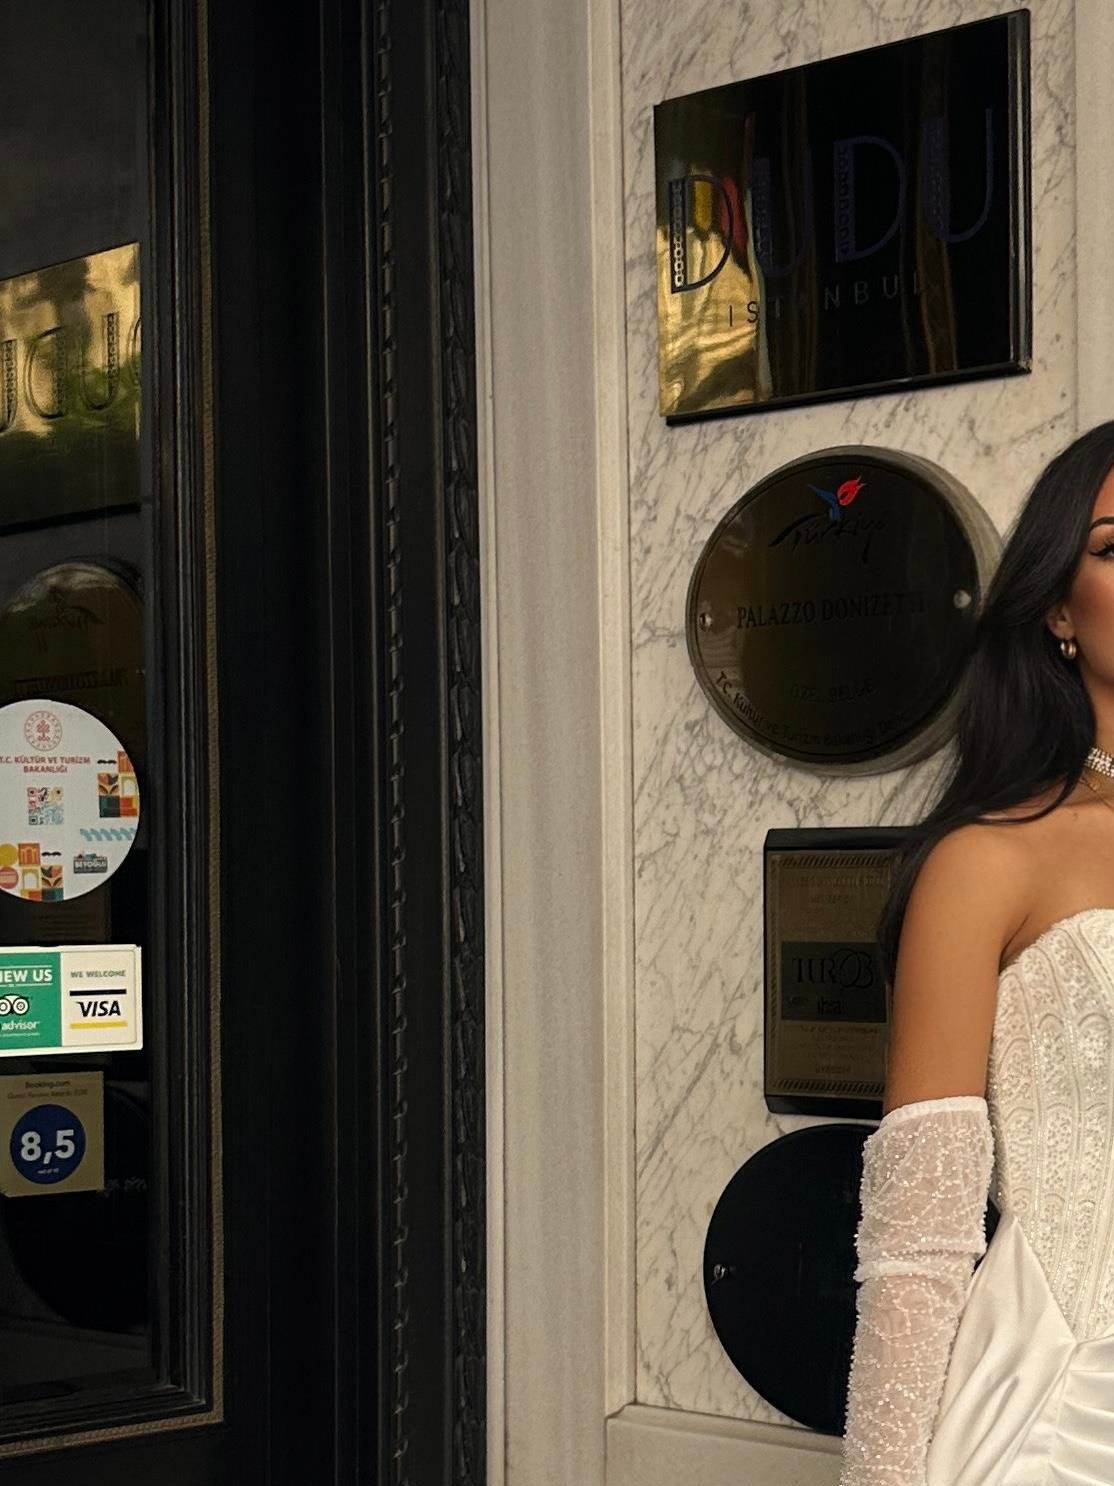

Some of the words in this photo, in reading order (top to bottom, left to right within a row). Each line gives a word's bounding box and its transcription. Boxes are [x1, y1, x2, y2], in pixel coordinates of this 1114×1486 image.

[737, 601, 816, 629] PALAZZO
[33, 969, 53, 982] US
[86, 970, 126, 978] WELCOME
[76, 1000, 121, 1017] VISA
[20, 1129, 76, 1165] 8,5
